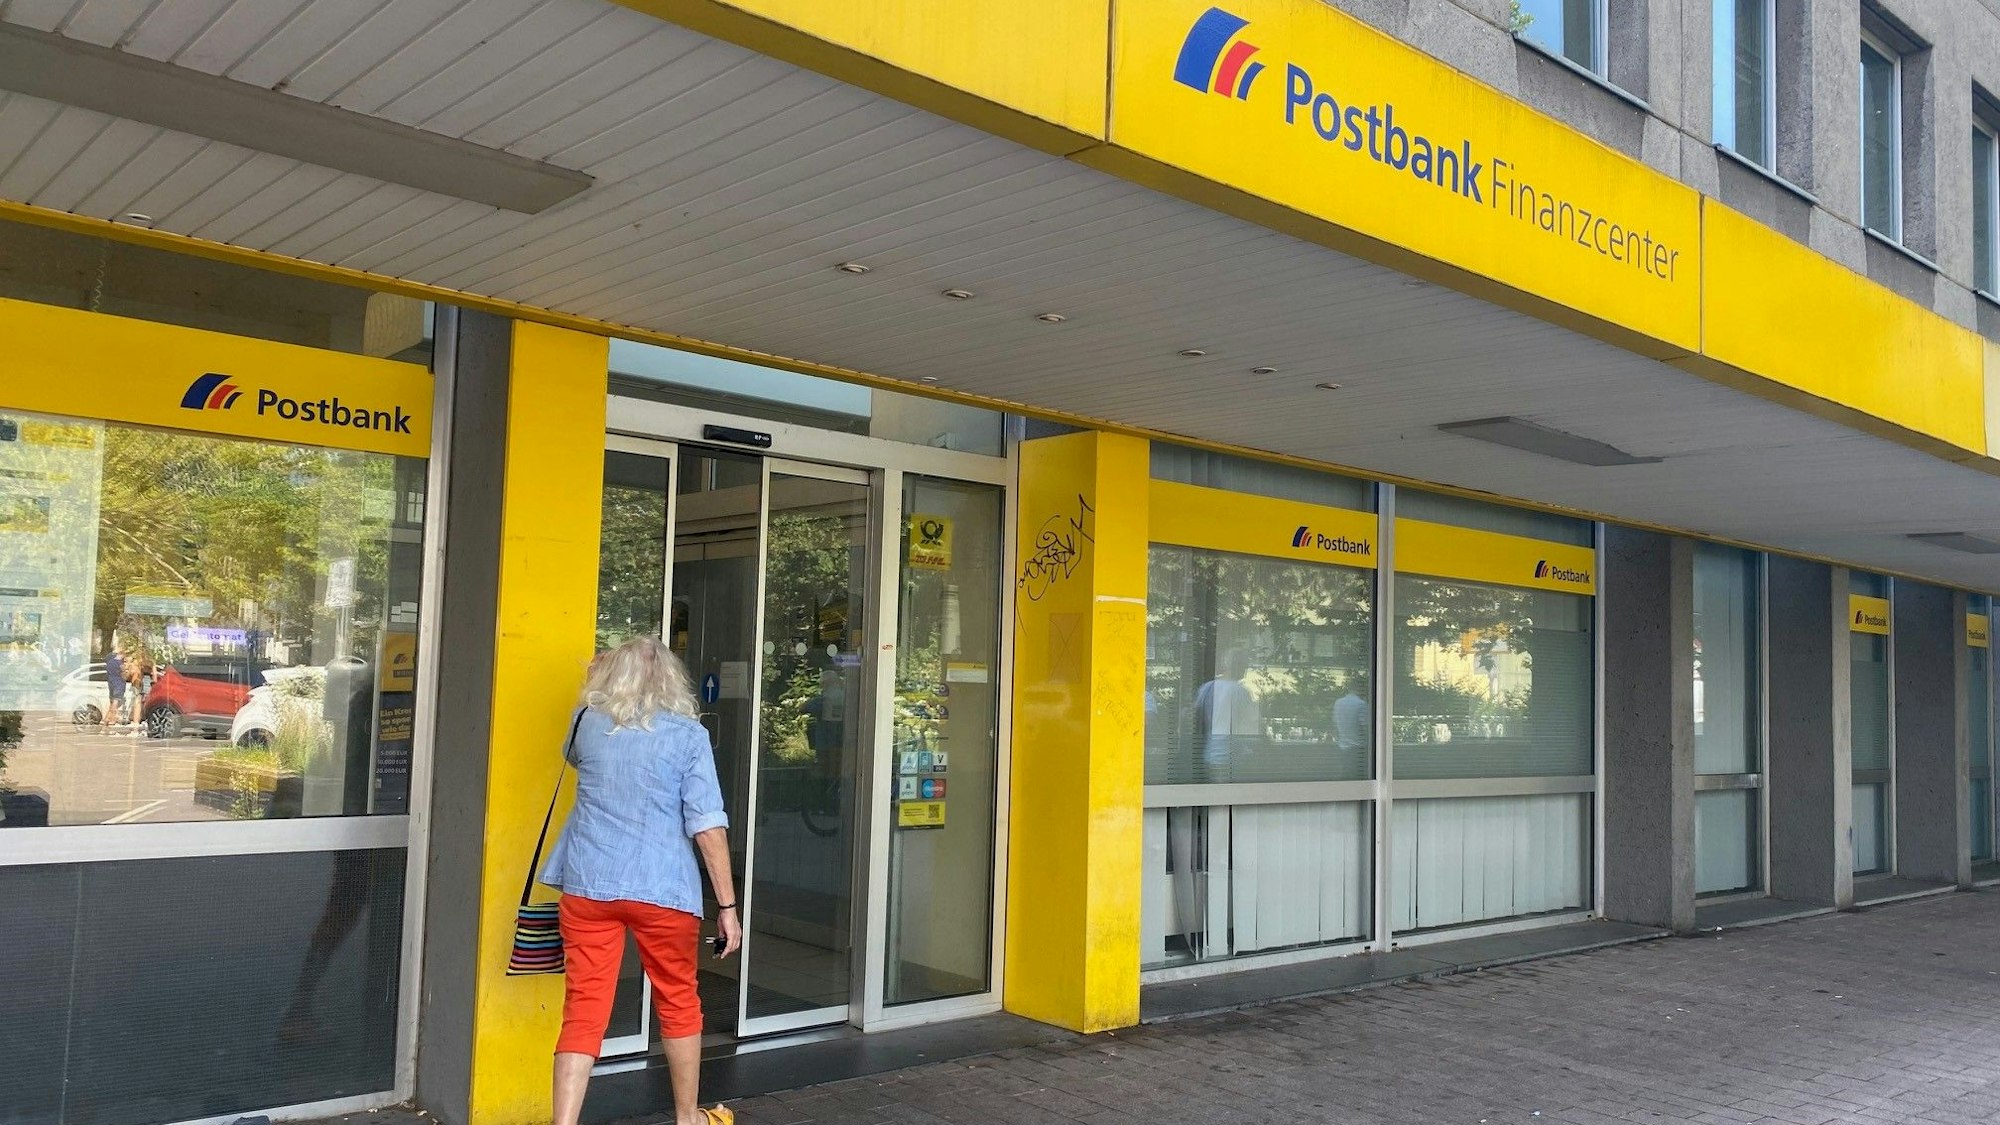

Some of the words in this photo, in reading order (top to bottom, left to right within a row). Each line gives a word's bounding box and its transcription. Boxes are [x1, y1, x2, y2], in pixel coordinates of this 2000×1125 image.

[1285, 62, 1483, 204] Postbank
[1491, 157, 1680, 283] Finanzcenter
[257, 388, 412, 435] Postbank
[1316, 533, 1371, 556] Postbank
[1551, 565, 1590, 584] Postbank
[1864, 614, 1888, 627] Postbank
